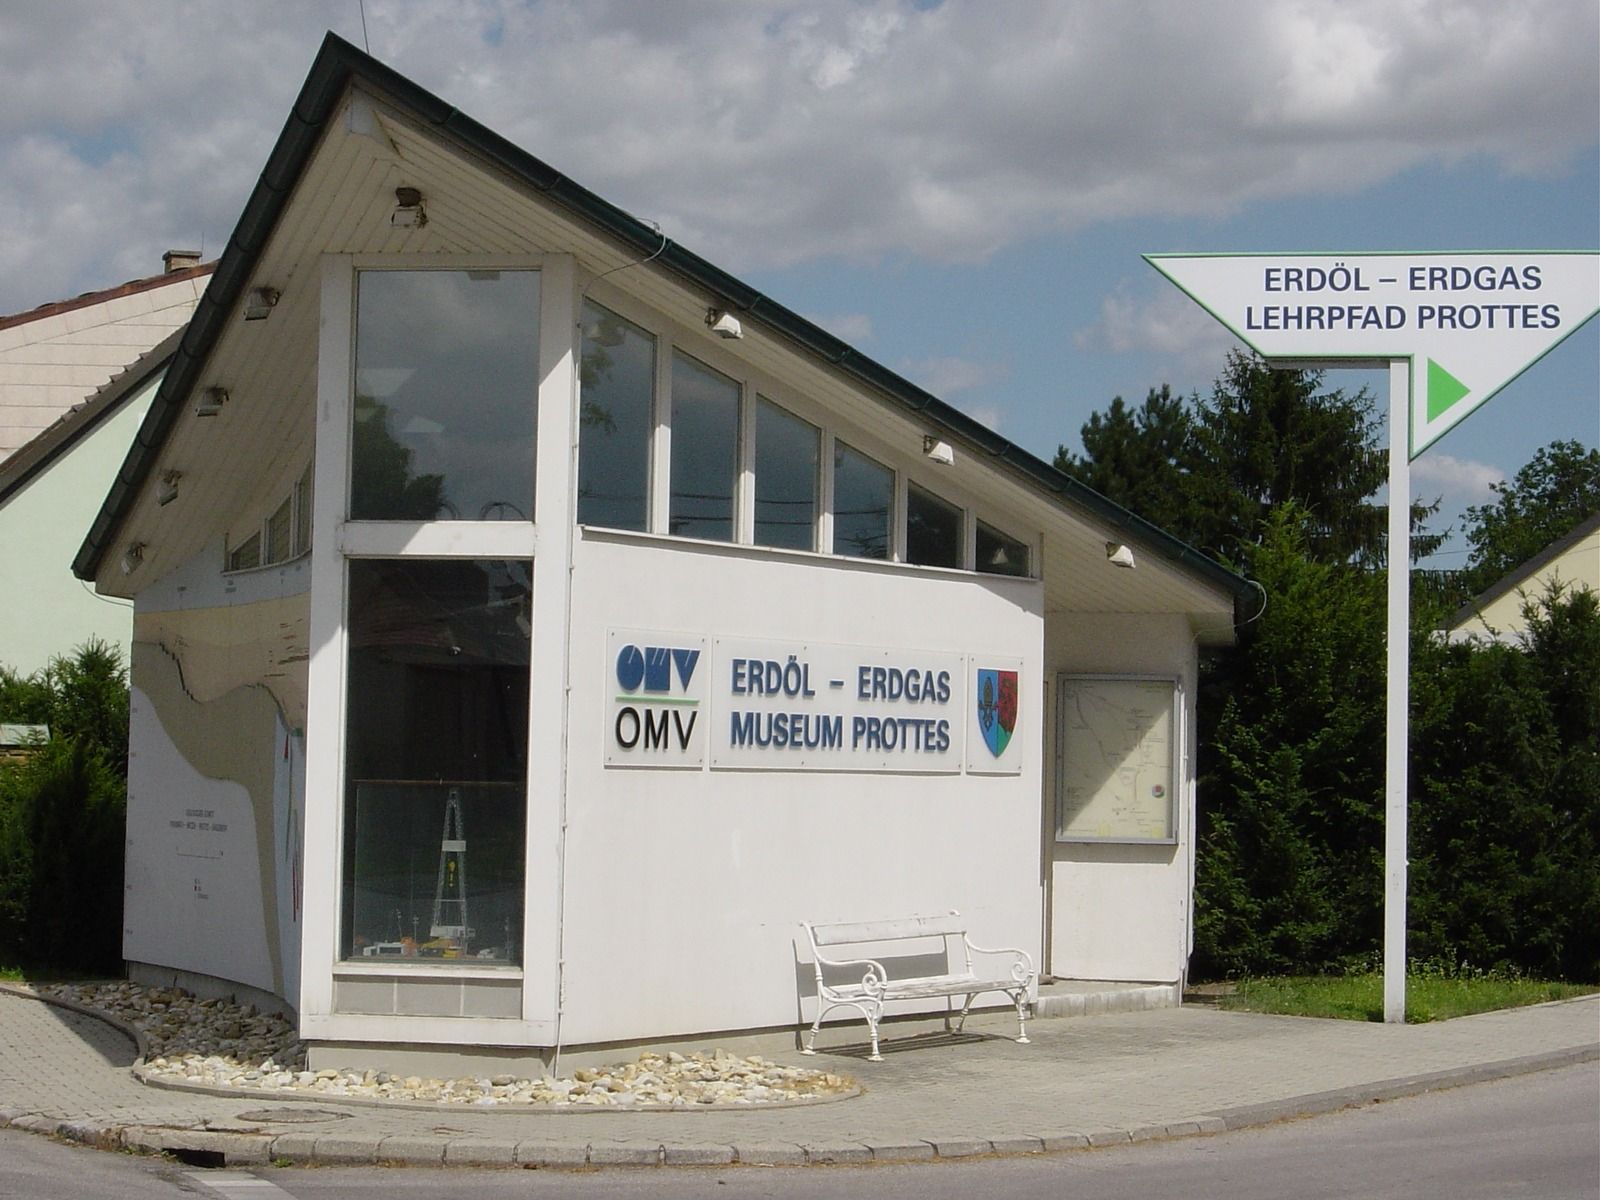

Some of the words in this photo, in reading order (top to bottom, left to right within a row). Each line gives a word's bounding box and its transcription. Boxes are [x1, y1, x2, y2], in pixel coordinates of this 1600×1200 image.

[1265, 262, 1370, 292] ERDÖL
[1409, 265, 1542, 291] ERDGAS
[1246, 305, 1407, 330] LEHRPFAD
[1418, 304, 1561, 330] PROTTES
[731, 654, 816, 700] ERDÖL
[857, 665, 951, 704] ERDGAS
[615, 706, 698, 751] OMV
[730, 711, 843, 750] MUSEUM
[852, 716, 951, 754] PROTTES
